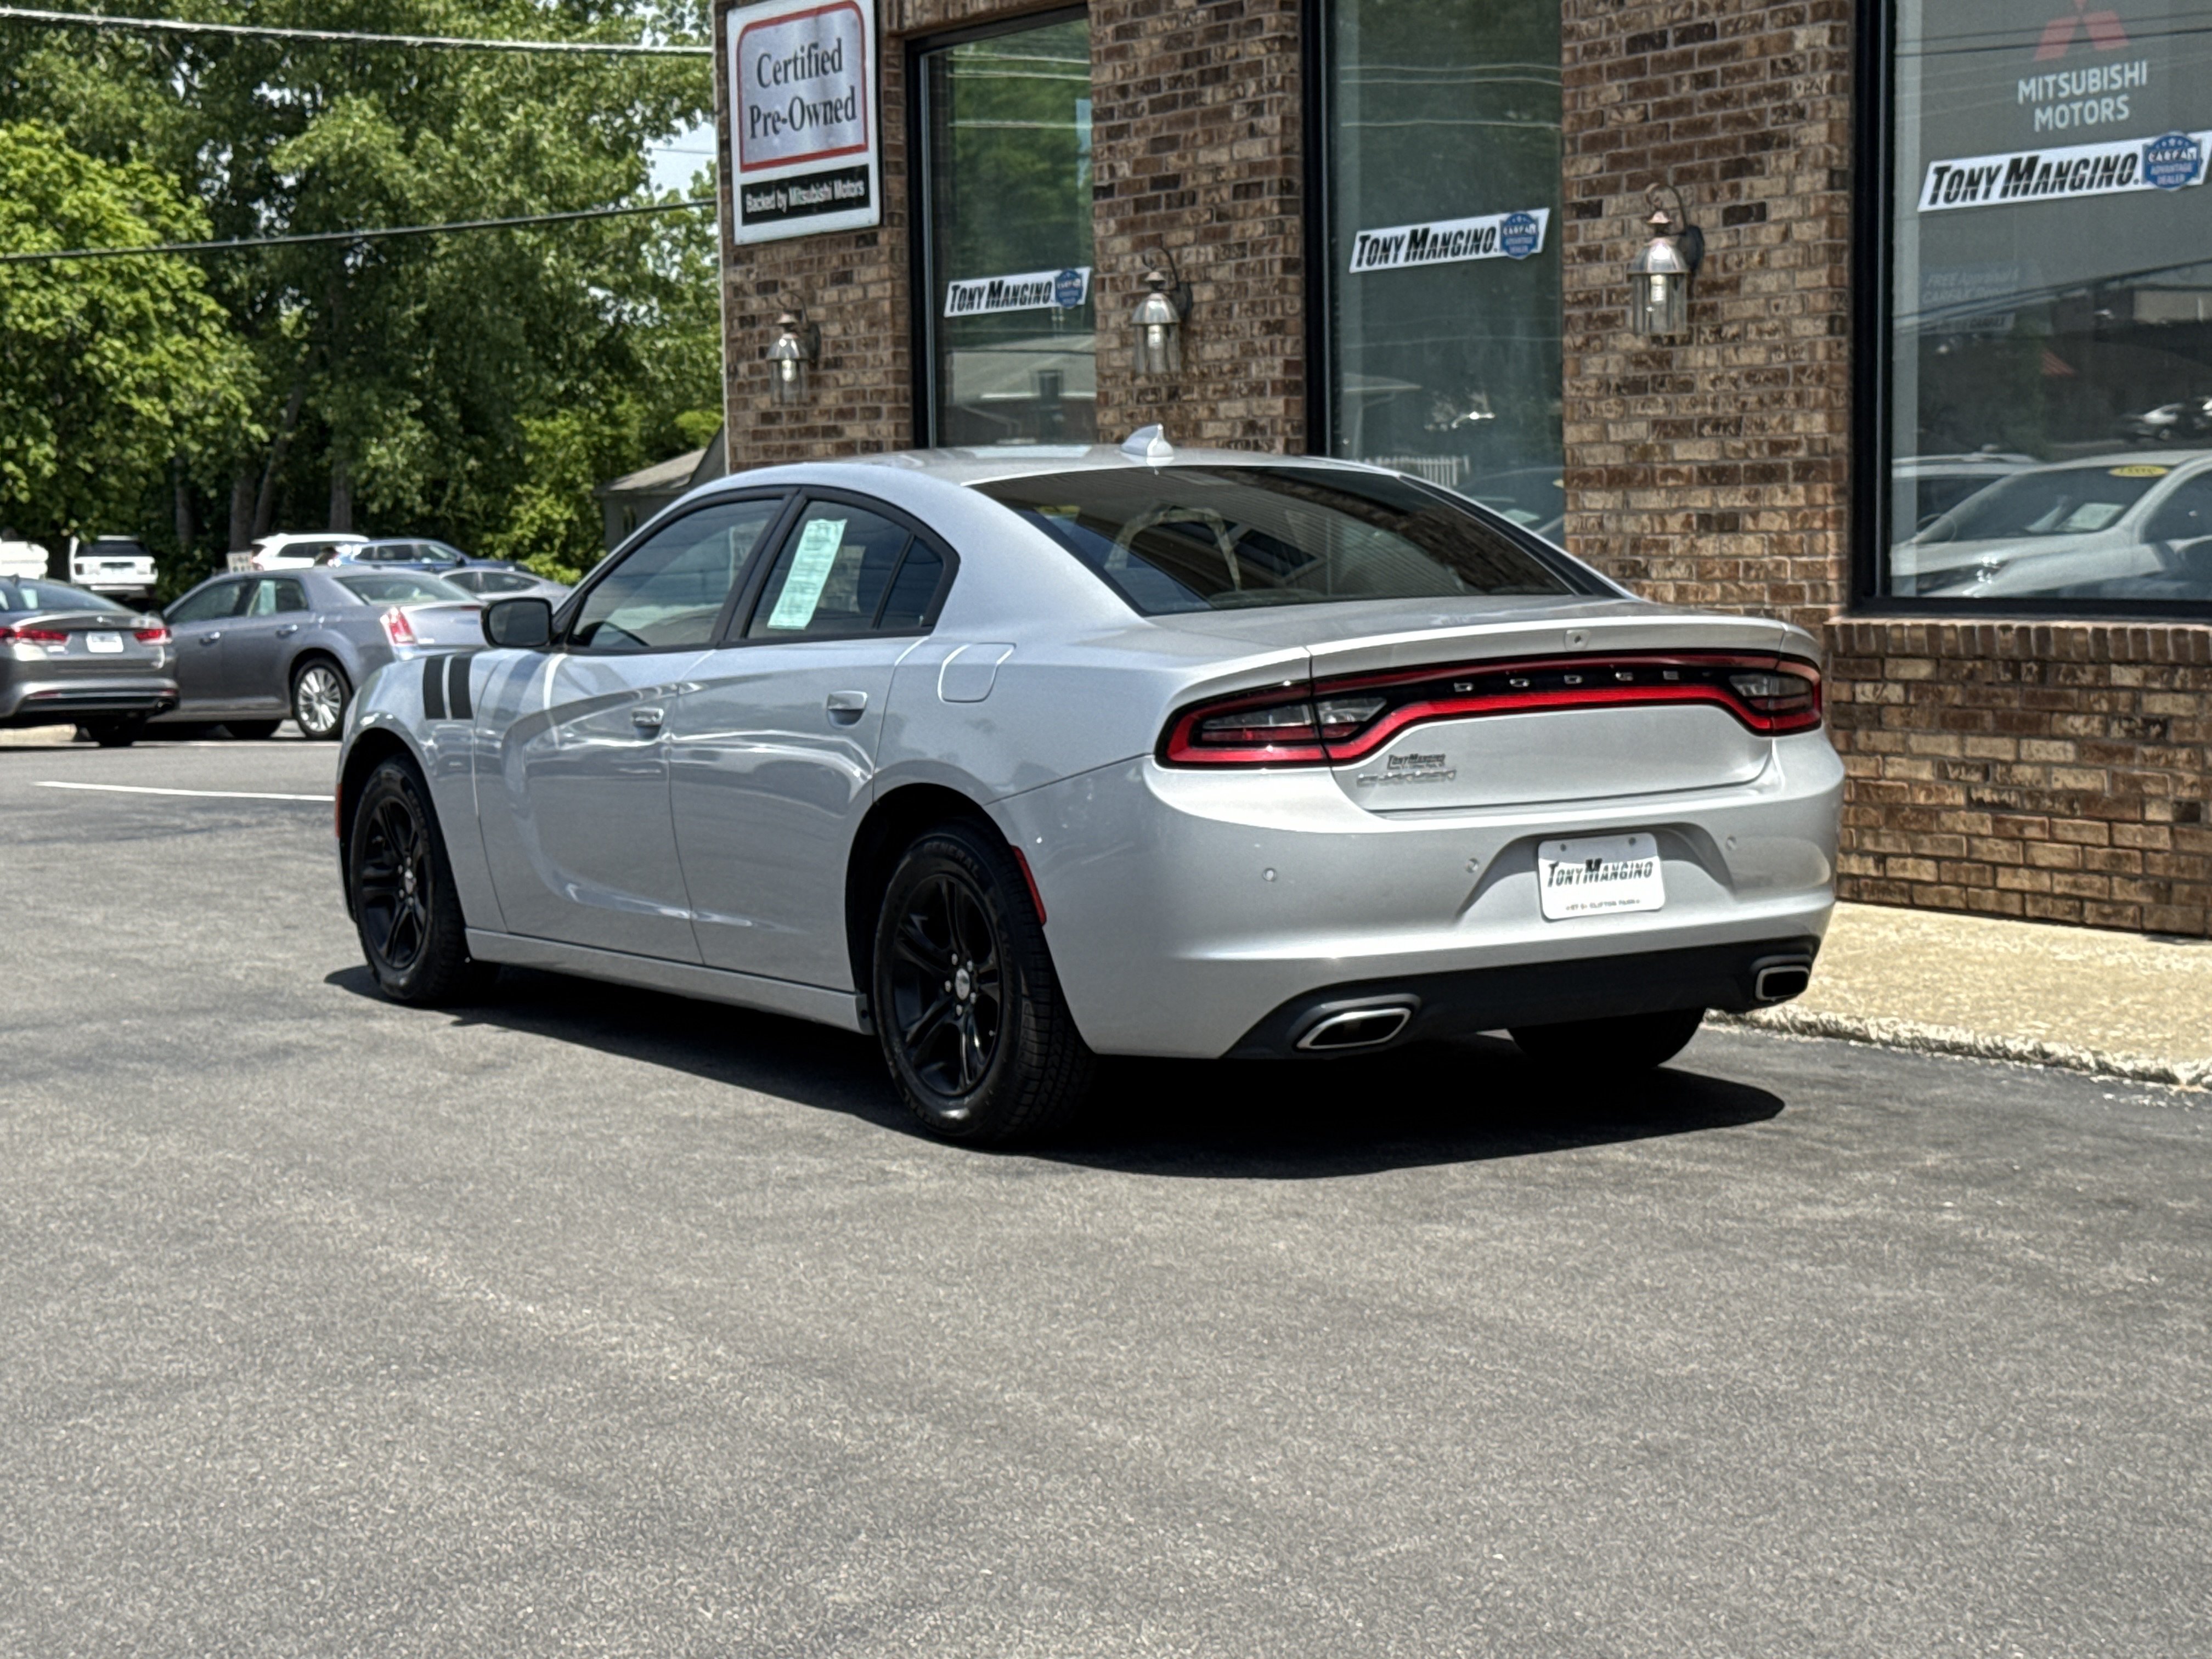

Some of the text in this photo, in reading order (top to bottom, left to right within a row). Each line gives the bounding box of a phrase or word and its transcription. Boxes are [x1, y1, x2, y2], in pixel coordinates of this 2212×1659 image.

[757, 37, 843, 89] Certified
[2017, 60, 2148, 105] MITSUBISHI
[749, 85, 857, 139] Pre-Owned
[2034, 93, 2130, 132] MOTORS
[1928, 164, 2004, 206] TONY
[1355, 234, 1406, 268] TONY
[950, 284, 986, 313] TONY
[923, 841, 979, 880] GENERAL
[1547, 860, 1583, 888] TONY
